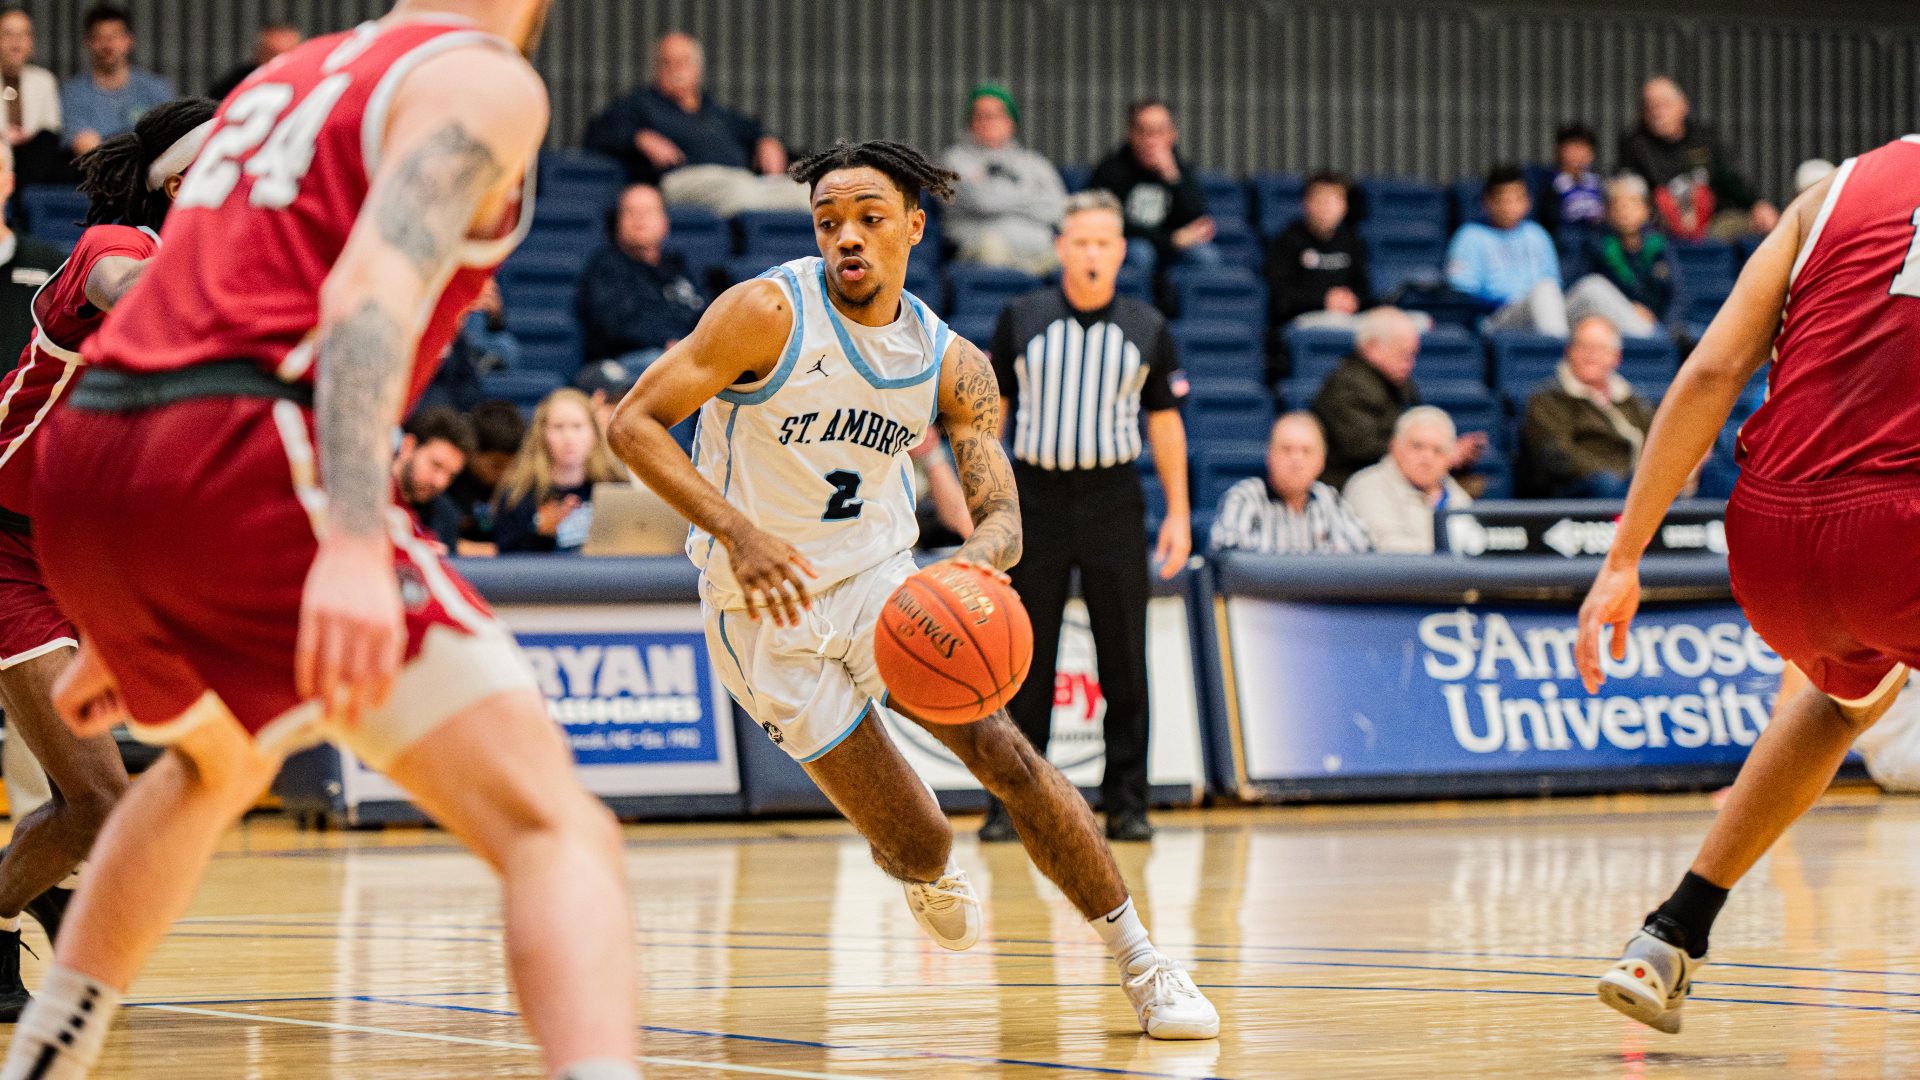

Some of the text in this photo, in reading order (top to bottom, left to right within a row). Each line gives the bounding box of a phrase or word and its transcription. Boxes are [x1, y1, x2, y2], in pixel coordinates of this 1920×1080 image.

[173, 72, 351, 209] 24
[779, 408, 917, 457] ST. AMBRO
[821, 468, 864, 522] 2
[520, 645, 698, 697] RYAN
